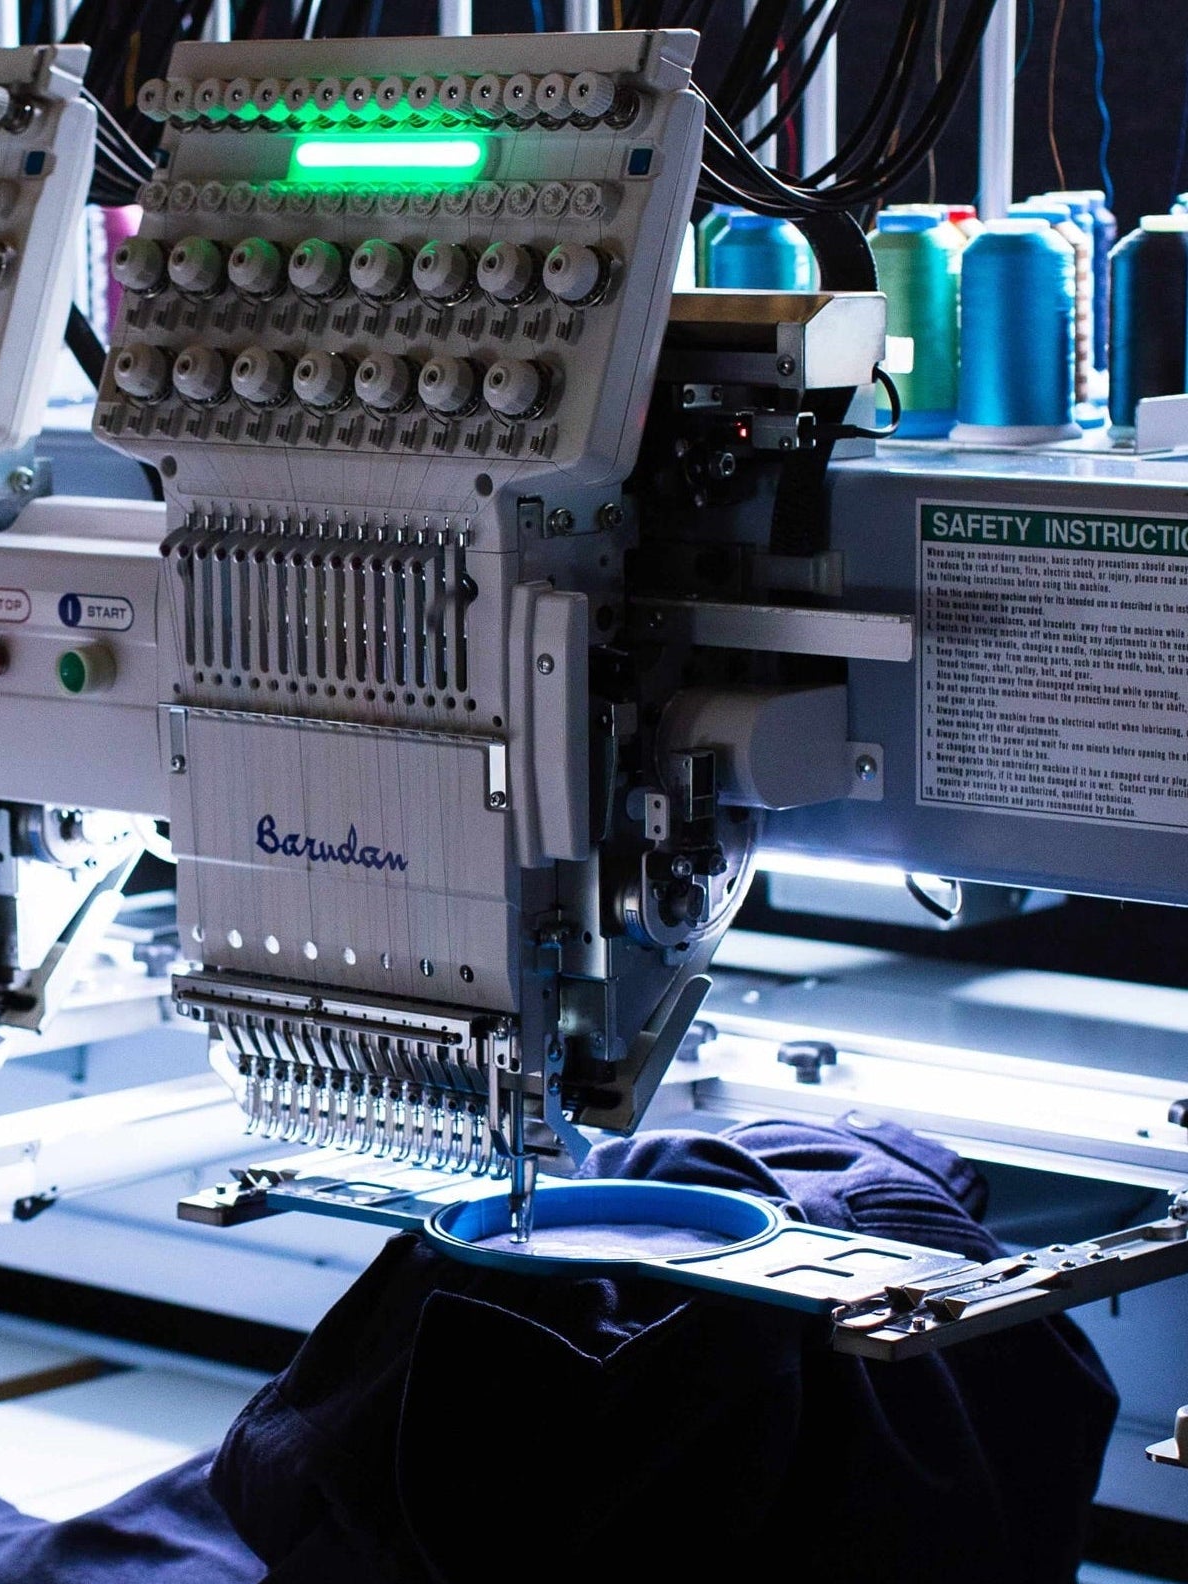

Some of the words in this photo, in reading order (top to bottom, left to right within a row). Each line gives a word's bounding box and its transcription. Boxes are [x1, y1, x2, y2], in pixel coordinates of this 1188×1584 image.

[932, 512, 1031, 541] SAFETY
[87, 605, 127, 620] START
[256, 814, 409, 871] Barudan
